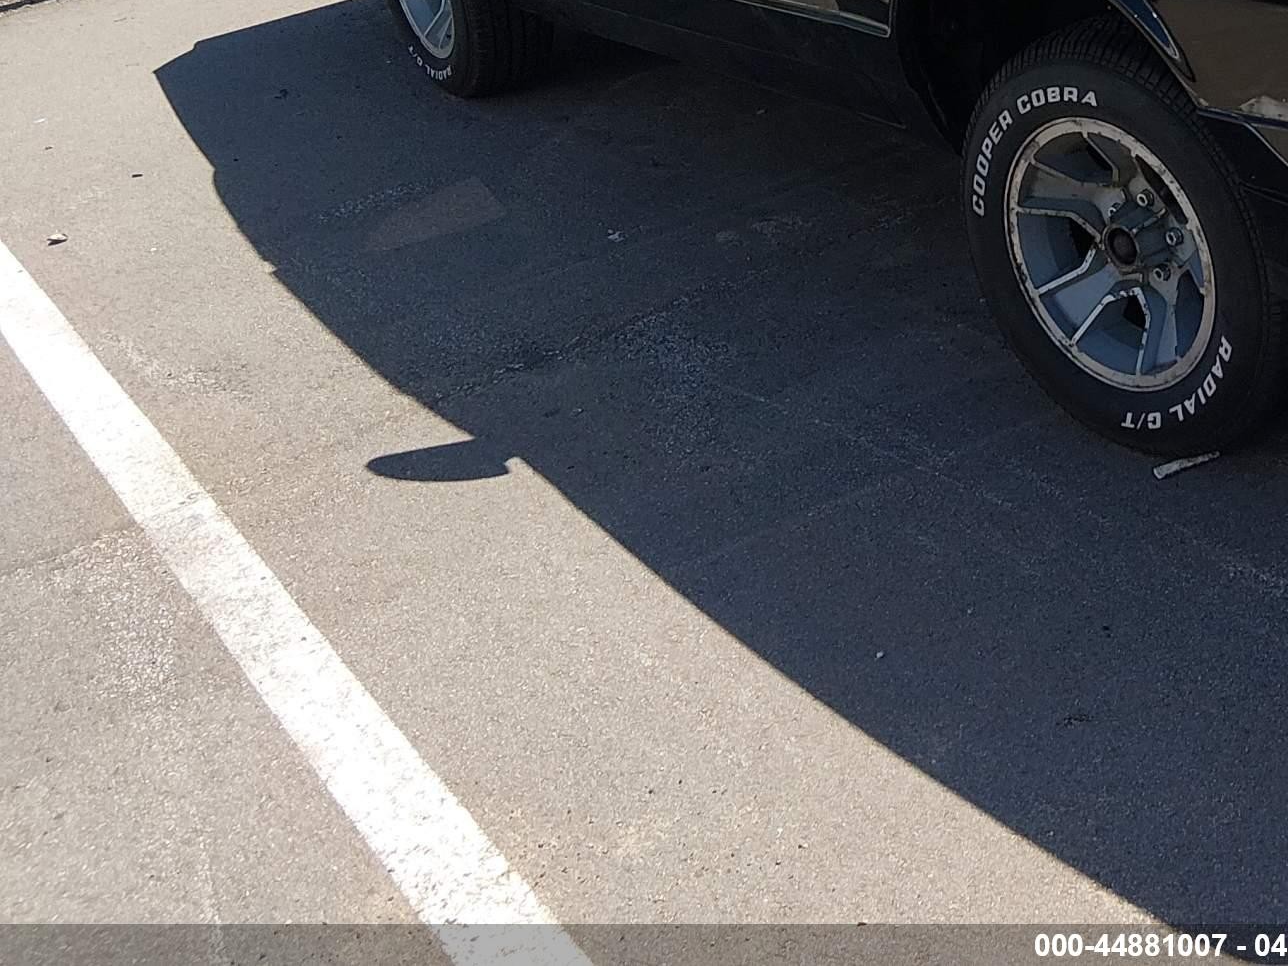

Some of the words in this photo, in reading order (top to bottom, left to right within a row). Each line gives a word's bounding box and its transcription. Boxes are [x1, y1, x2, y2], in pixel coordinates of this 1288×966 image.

[972, 110, 1013, 216] COOPER
[1016, 86, 1098, 115] COBRA
[1121, 412, 1161, 429] G/T
[1169, 335, 1232, 422] RADIAL
